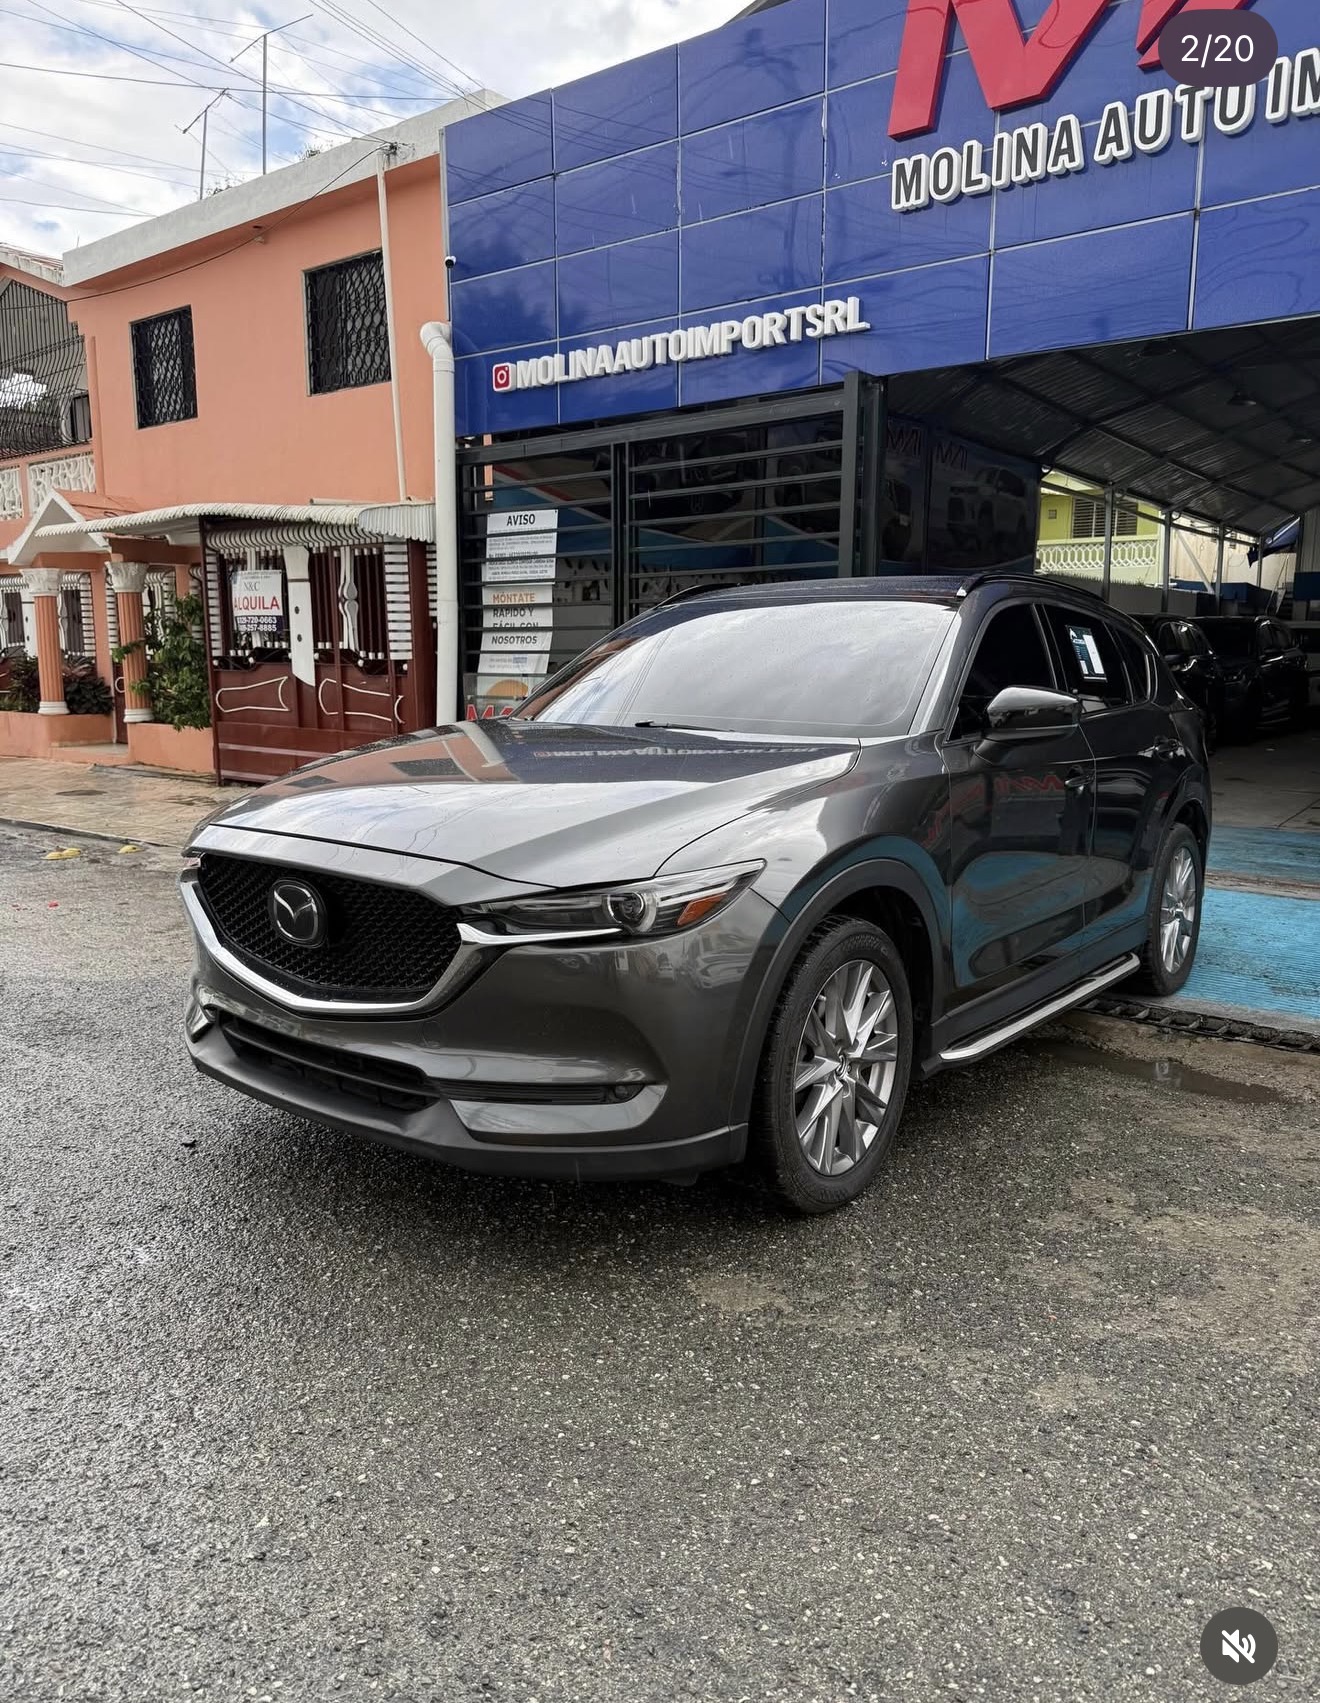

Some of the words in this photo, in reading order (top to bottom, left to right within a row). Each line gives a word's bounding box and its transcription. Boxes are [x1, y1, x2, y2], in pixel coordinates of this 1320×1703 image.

[891, 114, 1085, 212] MOLINA
[1093, 84, 1257, 163] AUTO
[516, 296, 871, 391] MOLINAAUTOIMPORTSRL
[506, 513, 536, 526] AVISO
[491, 635, 539, 645] NOSOTROS
